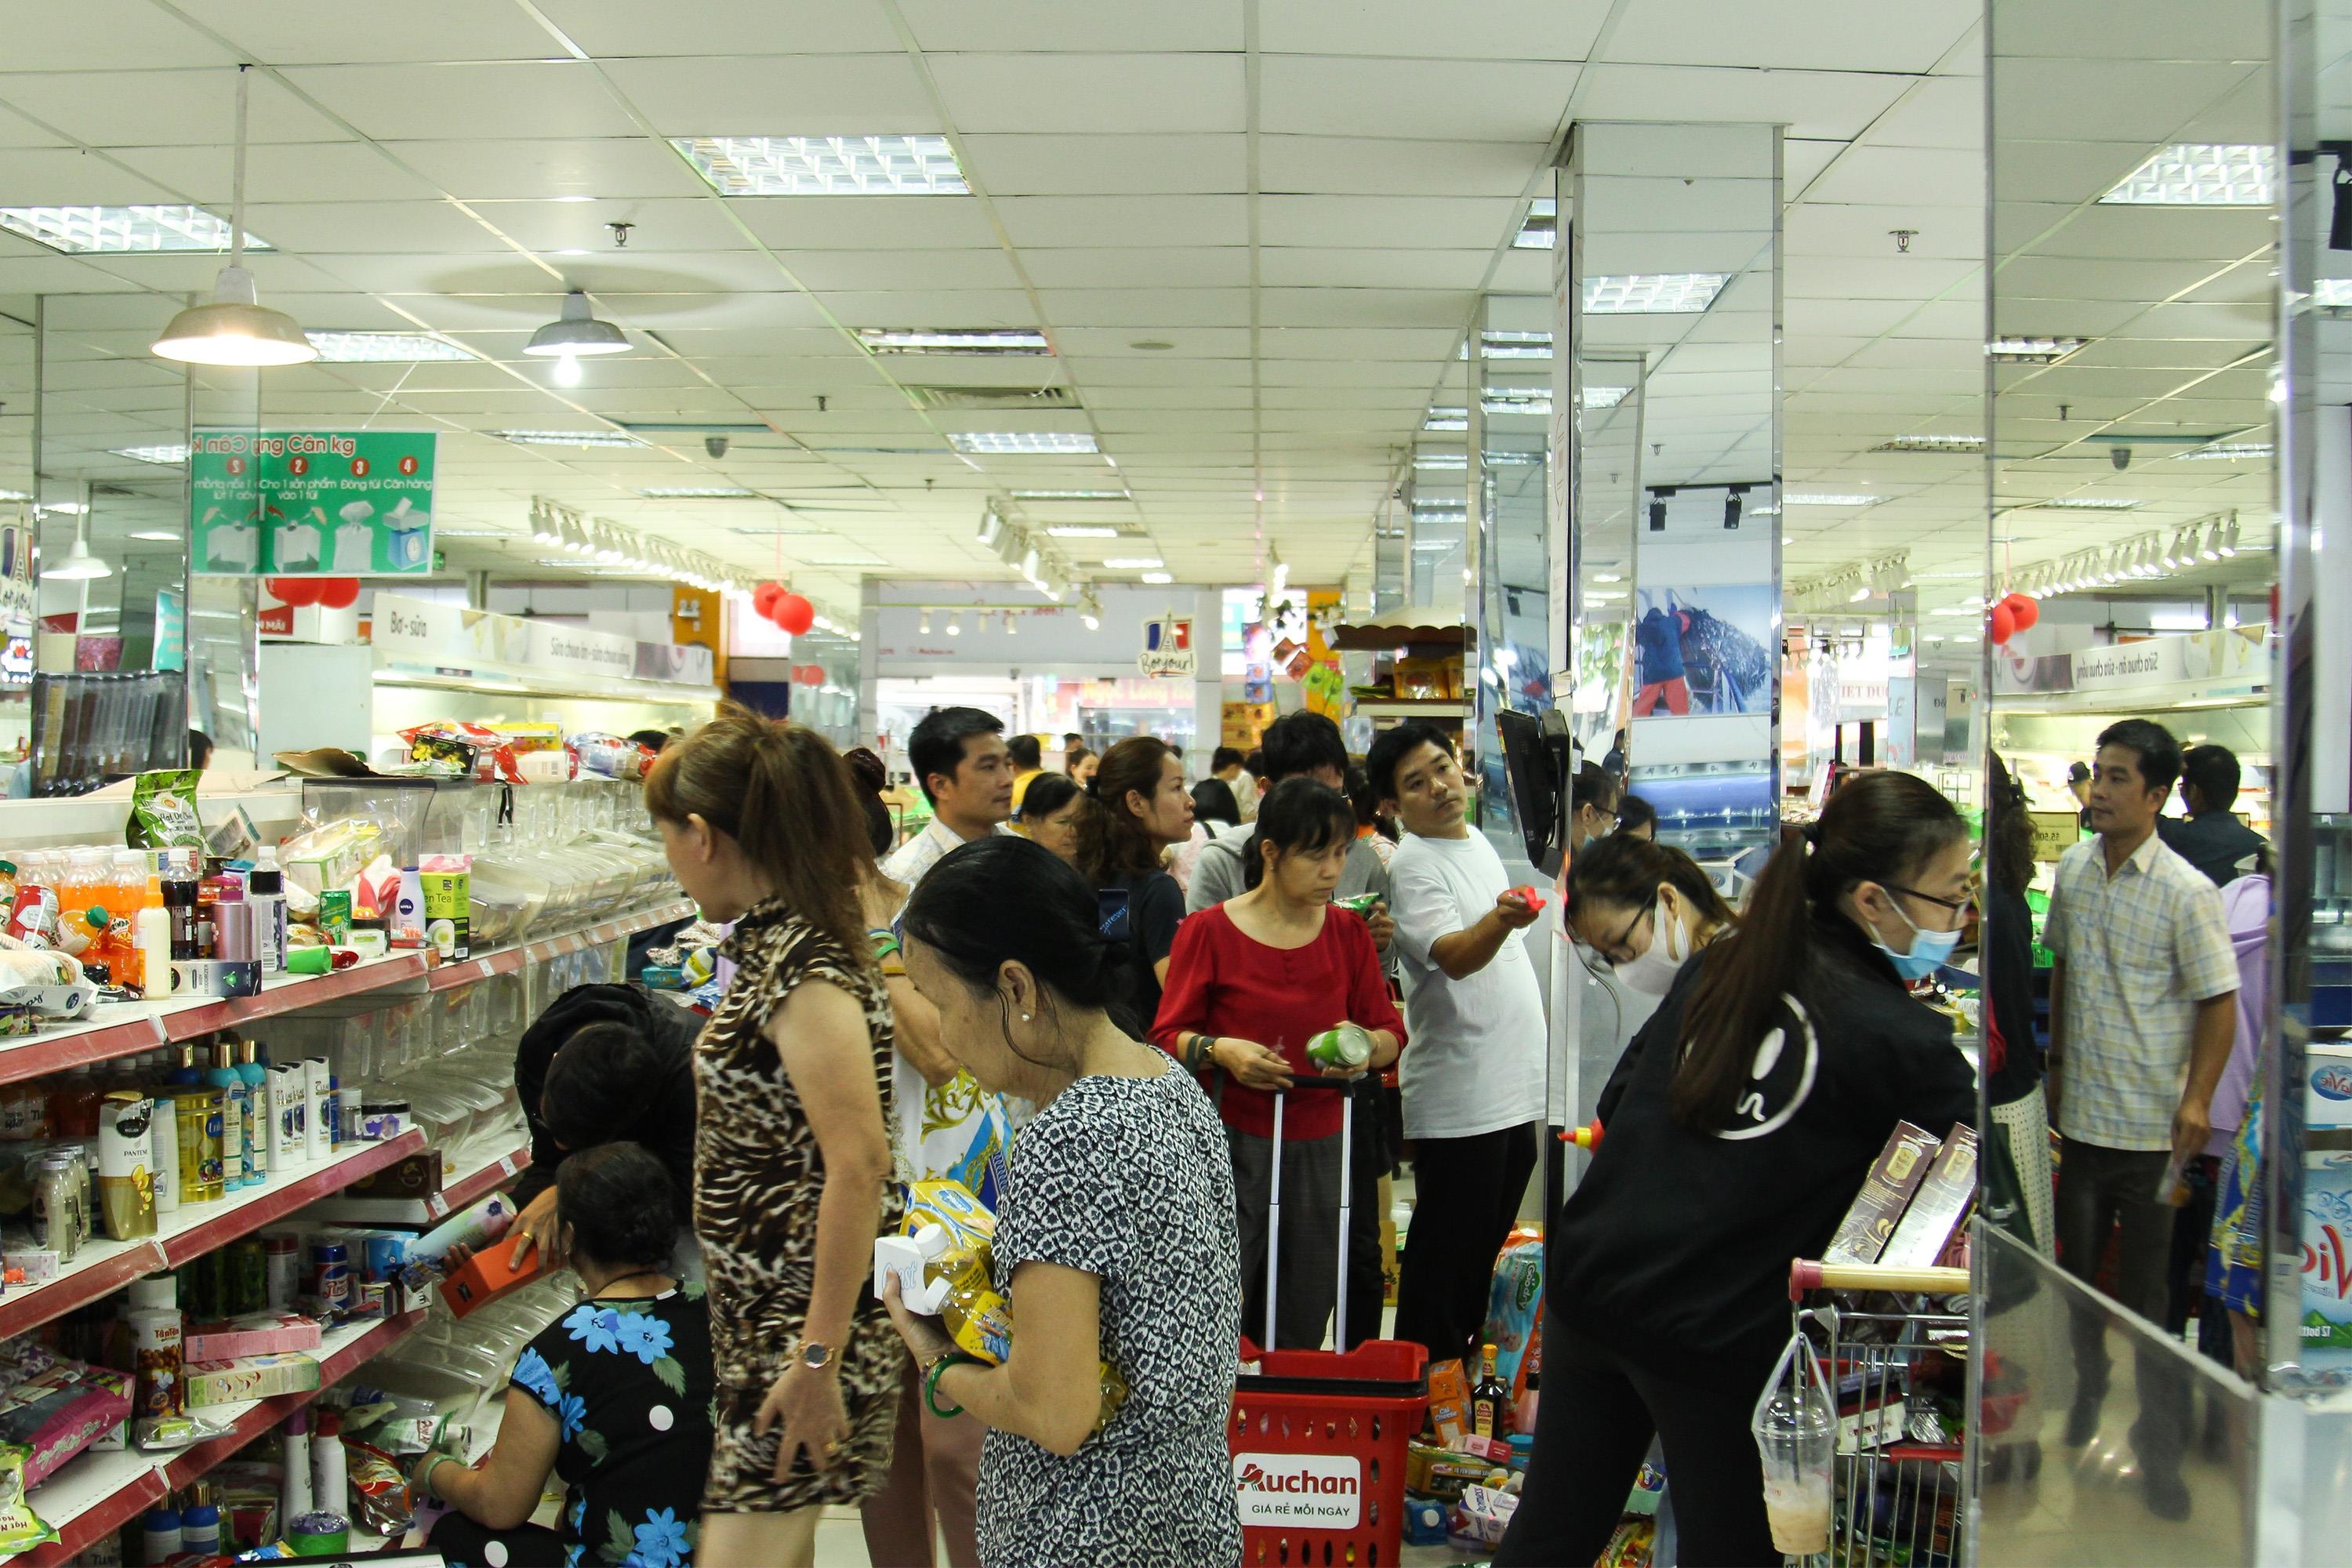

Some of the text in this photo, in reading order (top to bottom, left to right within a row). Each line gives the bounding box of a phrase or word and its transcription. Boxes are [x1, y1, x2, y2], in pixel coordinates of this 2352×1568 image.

[289, 435, 326, 453] Cân
[332, 436, 355, 456] kg
[1140, 653, 1194, 677] Bonjour!
[437, 893, 452, 903] Tea
[1435, 1411, 1458, 1421] Cheese
[1237, 1464, 1357, 1494] Auchan
[1252, 1503, 1350, 1516] GIÁ RẺ MỖI NGÀY
